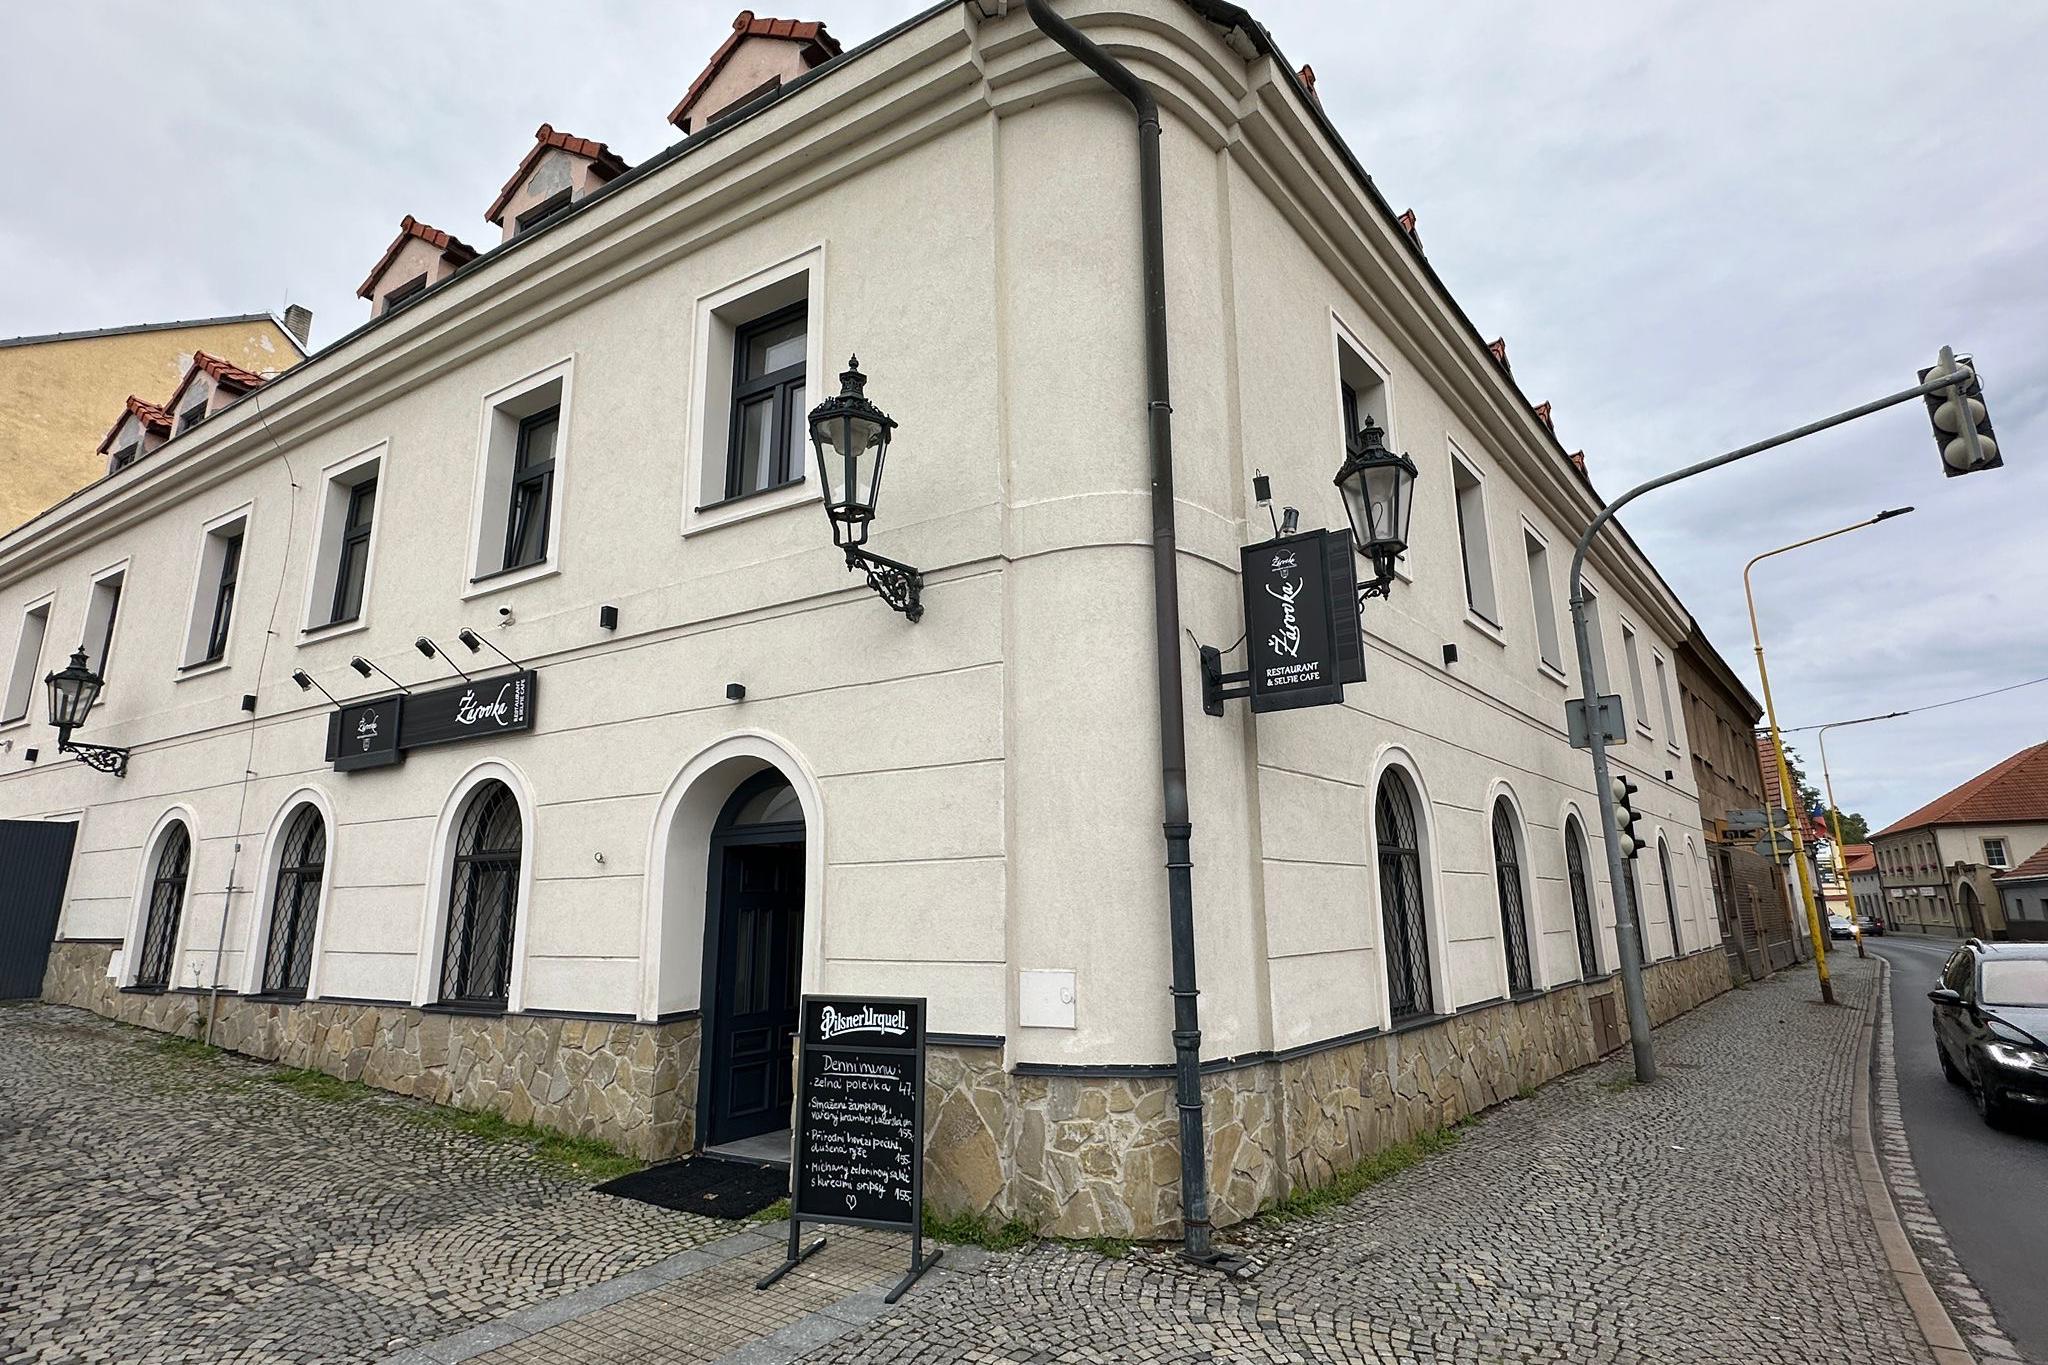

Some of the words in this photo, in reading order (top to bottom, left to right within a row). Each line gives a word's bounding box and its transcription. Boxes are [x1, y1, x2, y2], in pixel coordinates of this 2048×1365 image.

[1265, 576, 1304, 658] Žárovka
[1266, 661, 1319, 677] RESTAURANT
[1266, 678, 1274, 687] &
[1274, 674, 1299, 686] SELFIE
[1299, 671, 1321, 682] CAFE
[455, 682, 511, 726] Žárovka
[513, 680, 521, 722] RESTAURANT
[820, 1005, 864, 1040] Pilsner
[846, 1078, 891, 1093] polévka
